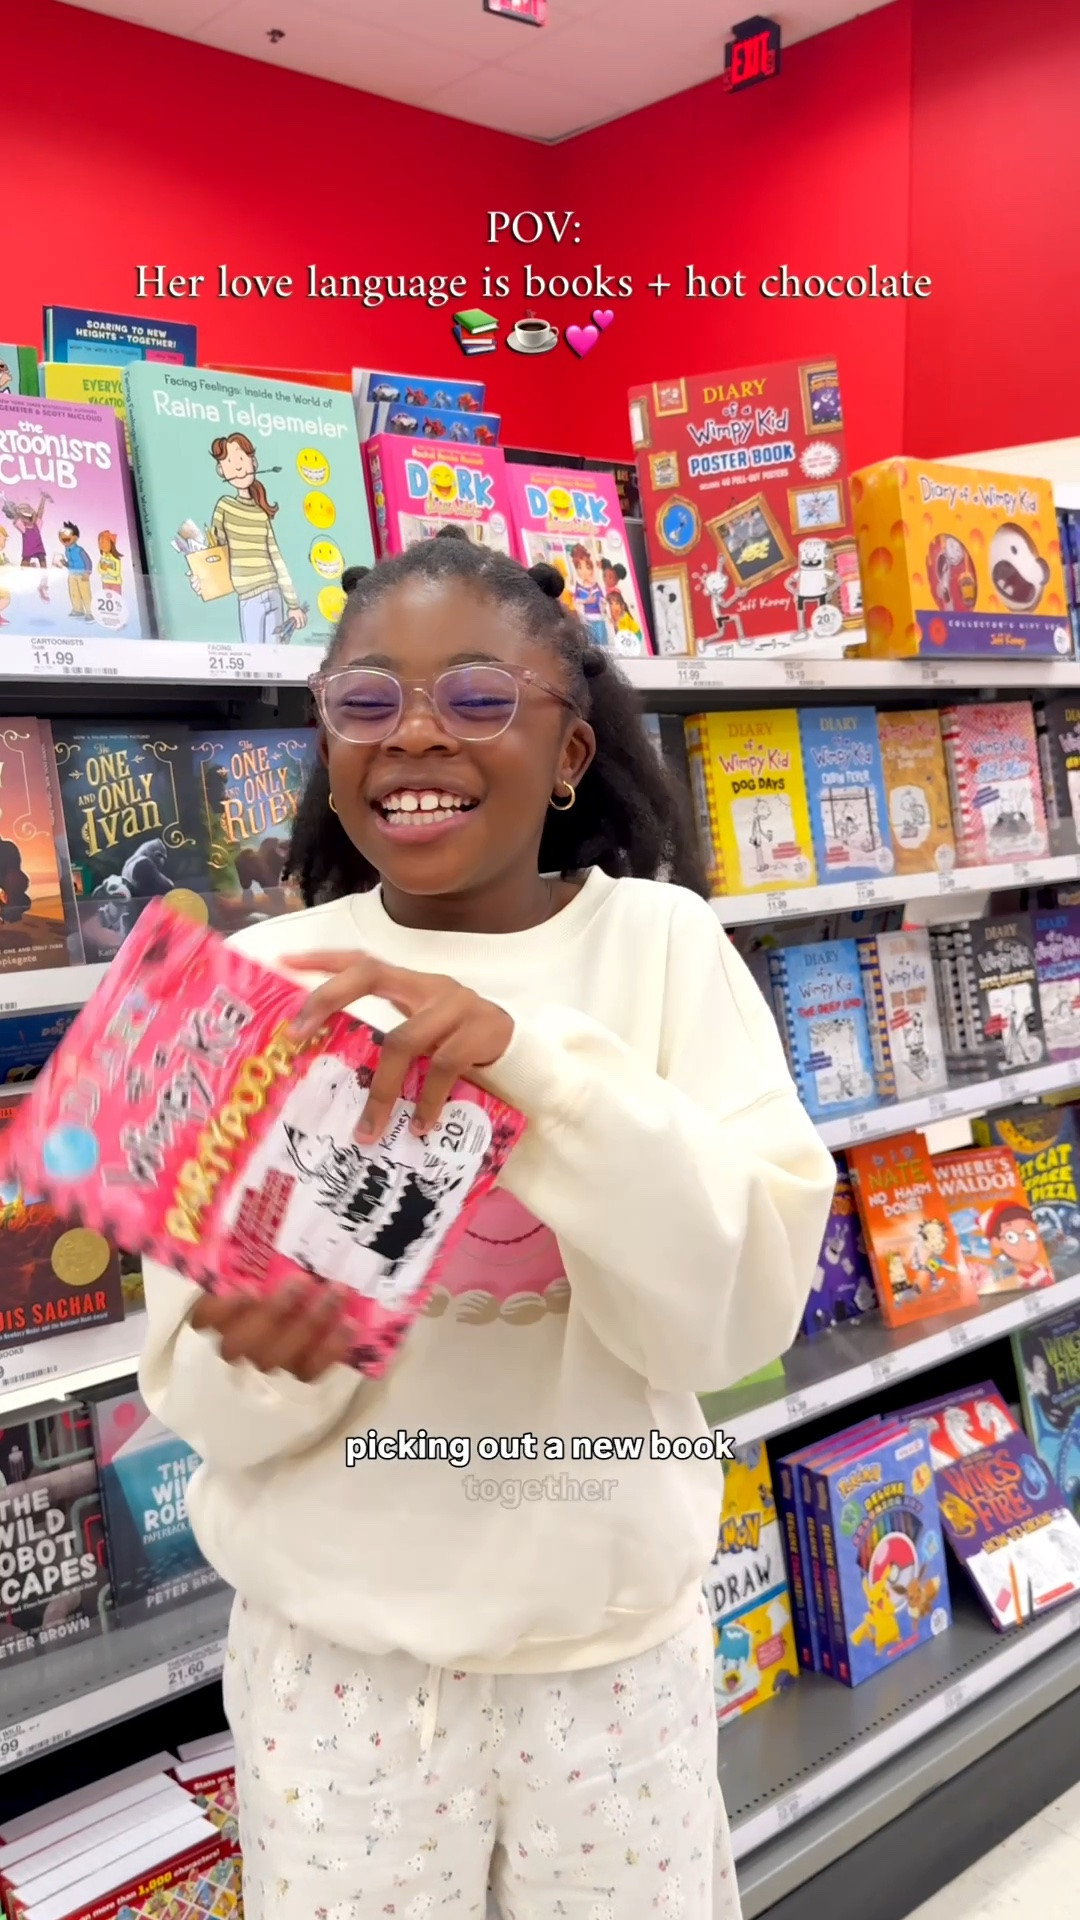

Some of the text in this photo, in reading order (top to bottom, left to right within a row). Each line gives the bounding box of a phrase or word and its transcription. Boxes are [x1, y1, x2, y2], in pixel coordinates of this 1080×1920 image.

[731, 30, 770, 86] EXIT
[76, 328, 117, 341] HEIGHTS
[127, 334, 177, 349] TOGETHER!
[86, 320, 168, 339] SOARING TO NEW
[164, 374, 333, 408] Facing Feelings: Inside the World of
[703, 378, 766, 404] DIARY
[42, 410, 66, 418] SCOTT
[153, 389, 348, 439] Raina Telgemeier
[722, 402, 738, 417] of
[687, 406, 789, 447] Wimpy Kid
[688, 448, 749, 477] POSTER
[750, 441, 795, 467] BOOK
[31, 638, 84, 647] CARTOONISTS
[33, 651, 74, 665] 11.99
[209, 657, 244, 670] 21.59
[728, 723, 773, 738] DIARY
[86, 750, 131, 786] ONE
[231, 746, 271, 780] ONE
[718, 748, 790, 777] Wimpy Kid
[78, 773, 153, 814] AND ONLY
[243, 767, 288, 804] ONLY
[731, 778, 785, 794] DOG DAYS
[804, 950, 839, 966] DIARY
[378, 1109, 411, 1151] Kinney
[933, 1157, 1012, 1180] WHERE'S
[1035, 1143, 1073, 1172] CAT
[868, 1158, 927, 1191] NATE
[936, 1170, 1017, 1197] WALDO?
[1031, 1182, 1077, 1204] PIZZA
[32, 1291, 107, 1325] SACHAR
[157, 1454, 200, 1480] THE
[0, 1488, 50, 1522] THE
[143, 1499, 189, 1532] ROB
[972, 1482, 1033, 1532] FIRE
[146, 1582, 188, 1609] PETER
[192, 1572, 217, 1591] BRO
[713, 1554, 772, 1612] DRAW
[39, 1616, 90, 1645] BROWN
[168, 1660, 204, 1686] 21.60
[92, 1902, 115, 1919] more
[117, 1890, 137, 1906] than
[138, 1871, 172, 1897] 1,000
